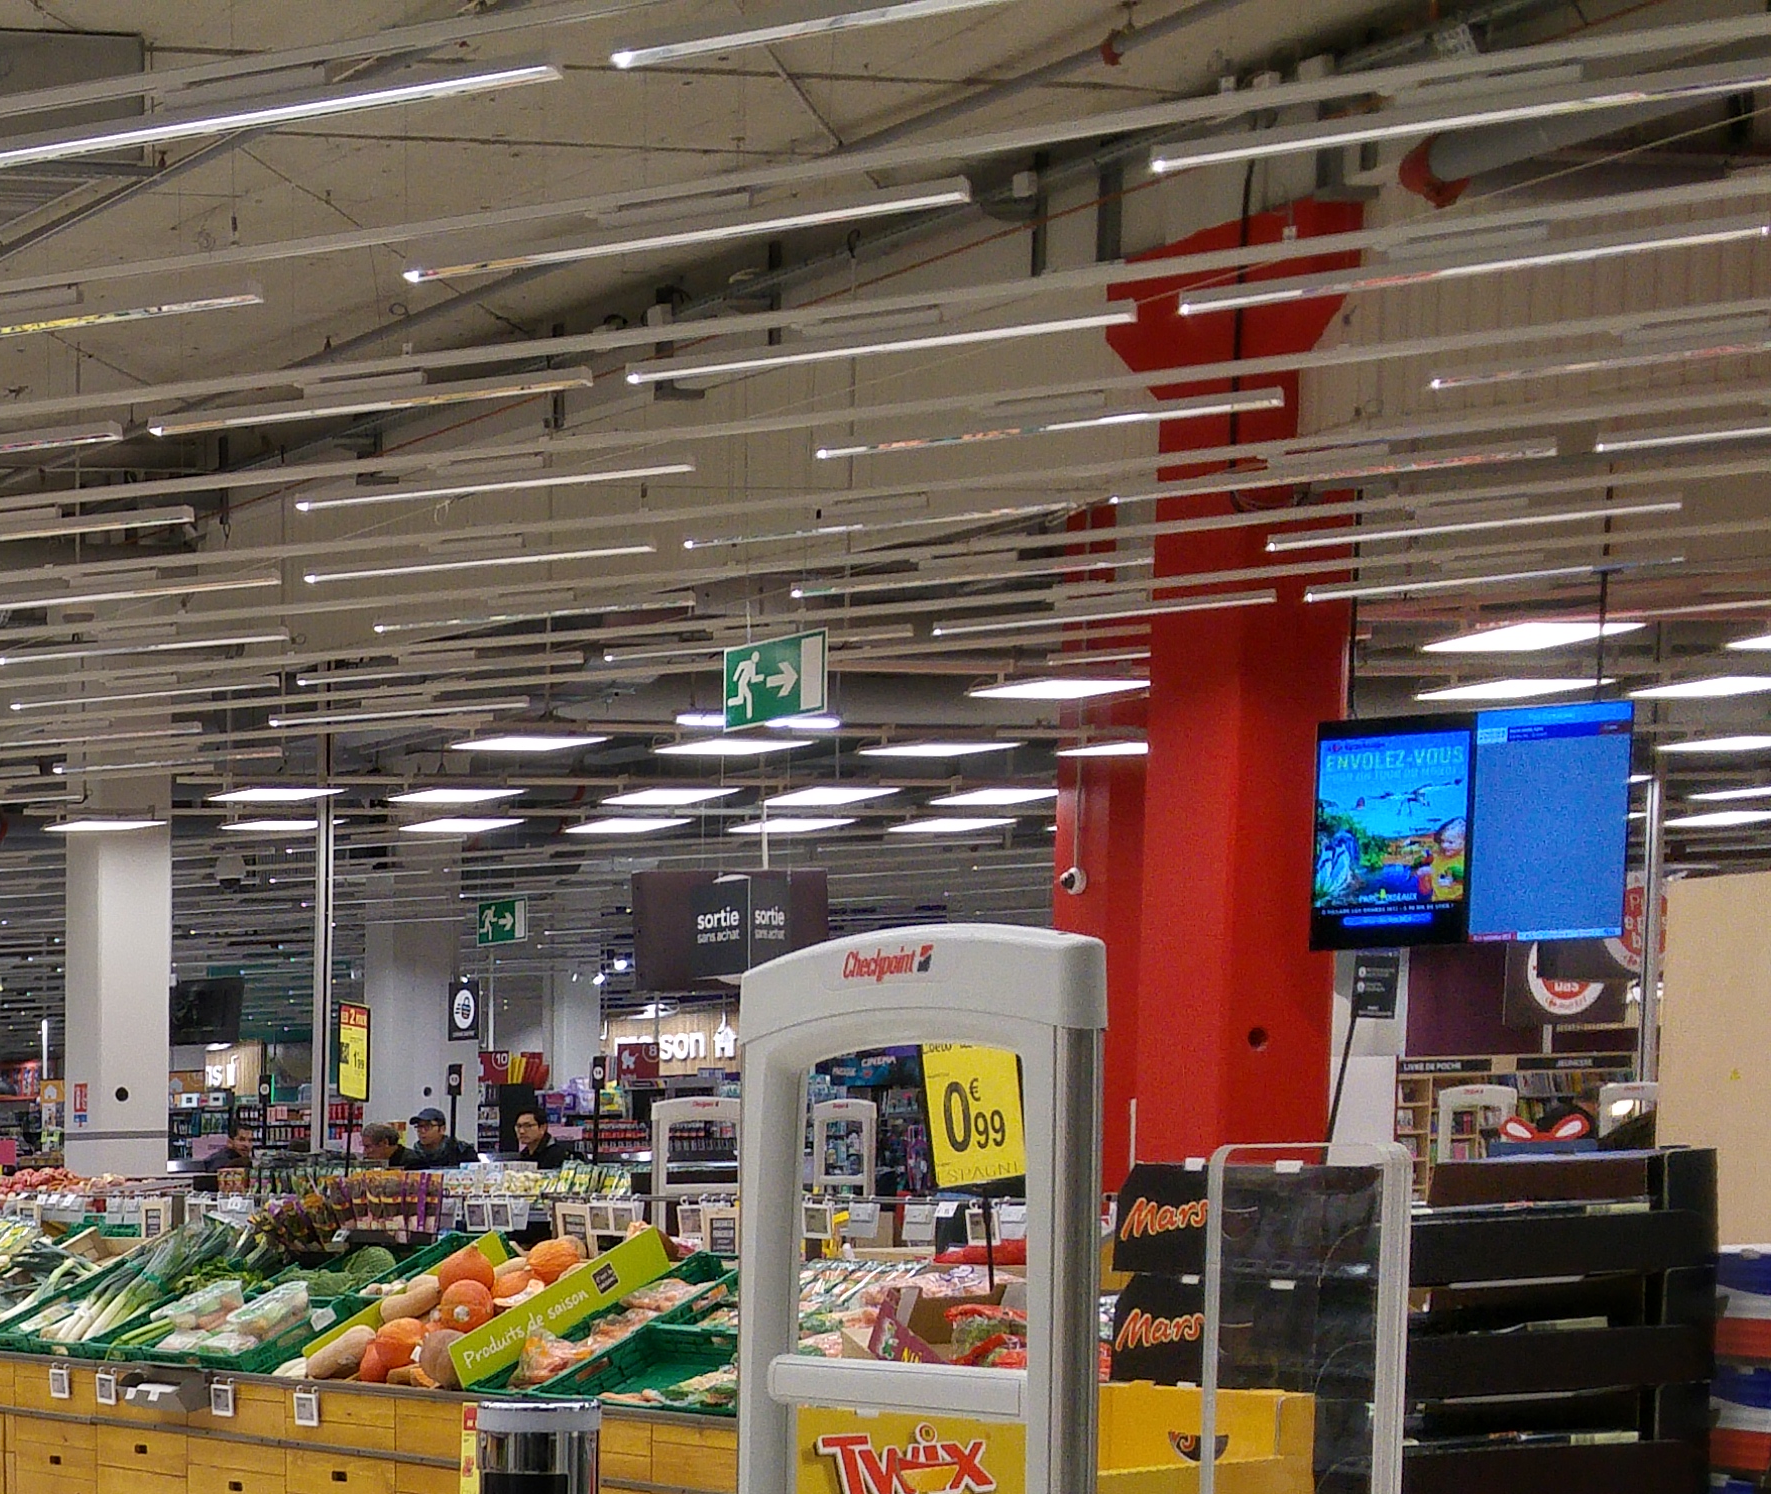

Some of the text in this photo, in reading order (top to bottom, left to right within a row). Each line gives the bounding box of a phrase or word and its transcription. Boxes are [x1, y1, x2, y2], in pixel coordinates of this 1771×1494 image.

[697, 906, 739, 930] sortie
[754, 906, 785, 925] sortie
[718, 928, 739, 941] achat
[843, 946, 914, 982] Checkpoint
[496, 1053, 508, 1064] 10
[1120, 1196, 1209, 1241] Mars
[463, 1289, 589, 1369] Produits de saison
[1115, 1308, 1205, 1351] Mars
